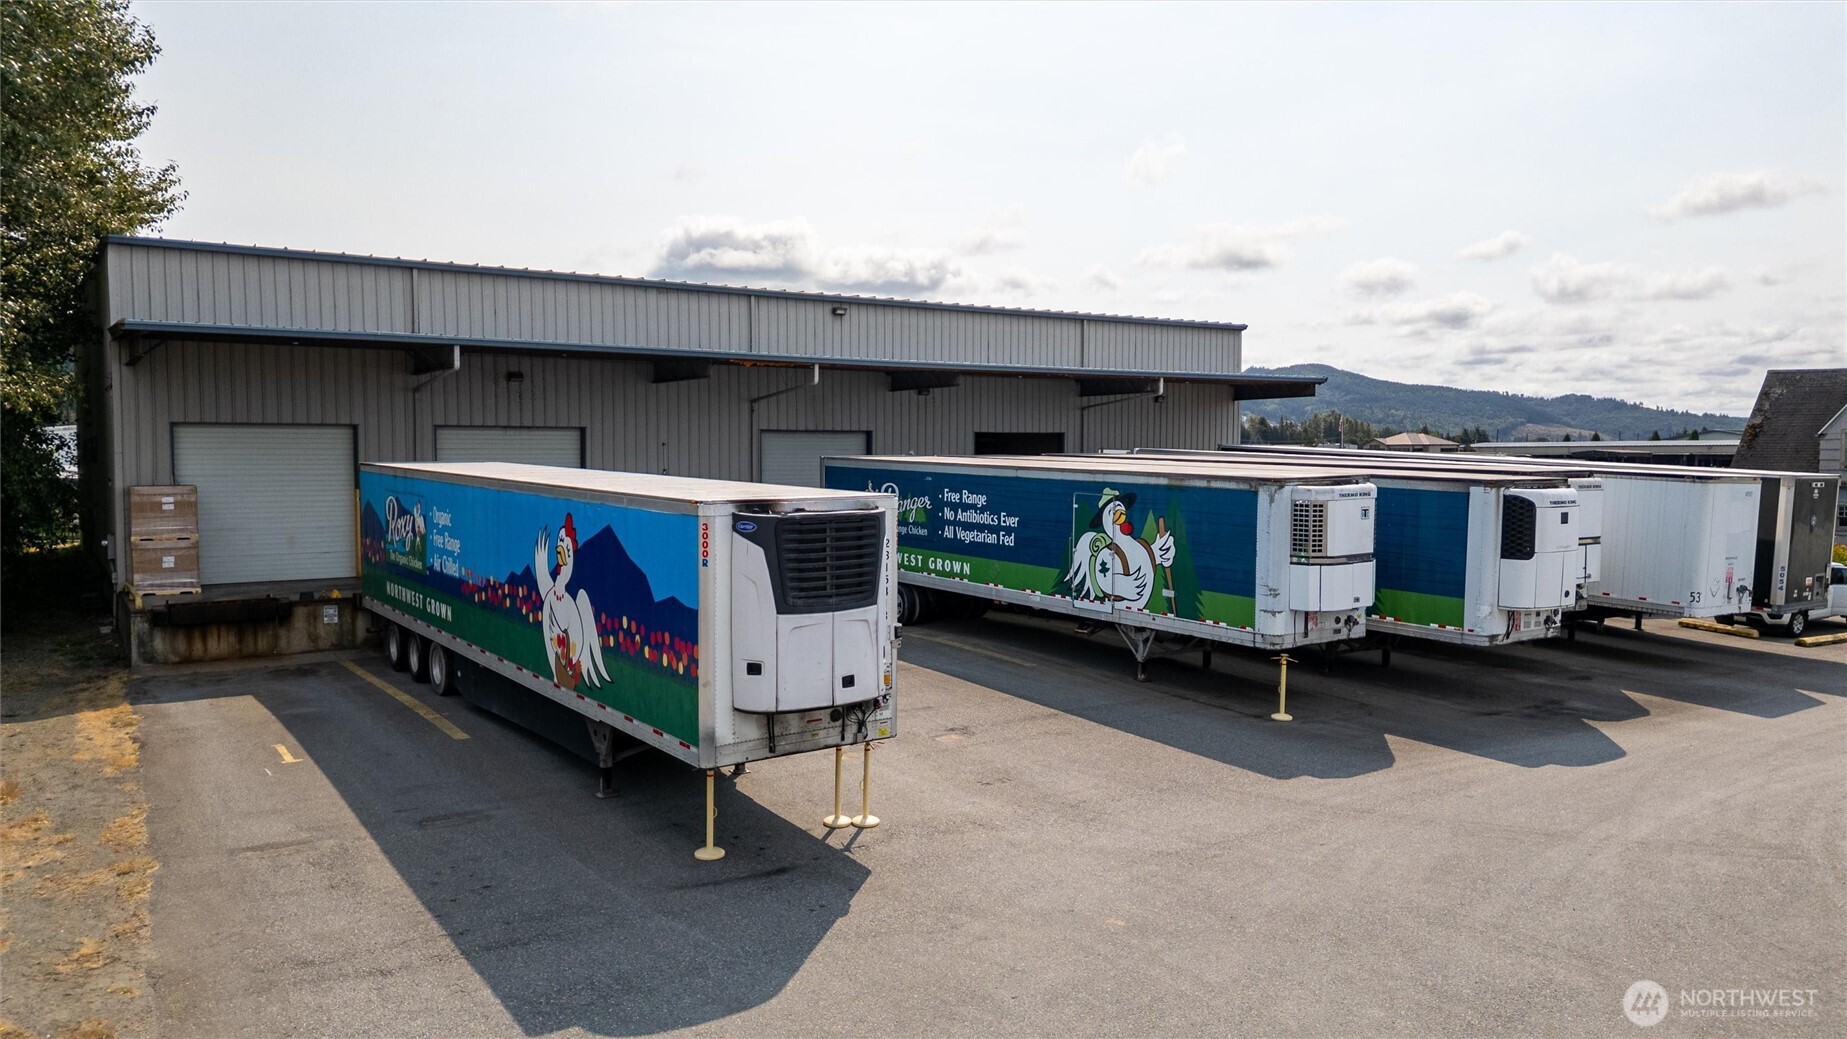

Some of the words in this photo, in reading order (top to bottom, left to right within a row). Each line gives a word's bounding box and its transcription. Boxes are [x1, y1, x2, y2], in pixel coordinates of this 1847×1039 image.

[944, 488, 960, 503] Free
[962, 490, 987, 507] Range
[386, 496, 414, 552] Roxy
[433, 505, 452, 528] Organic
[944, 507, 955, 520] No
[956, 508, 998, 526] Antibiotics
[1000, 512, 1019, 528] Ever
[908, 524, 928, 536] Chicken
[943, 525, 954, 539] All
[955, 526, 997, 544] Vegetarian
[999, 531, 1015, 547] Fed
[433, 528, 444, 549] Free
[444, 531, 460, 557] Range
[433, 552, 442, 573] Air
[442, 555, 460, 579] Chilled
[897, 552, 923, 568] WEST
[929, 557, 970, 575] GROWN
[386, 580, 424, 610] NORTHWEST
[425, 597, 453, 622] GROWN
[1690, 592, 1702, 603] 53
